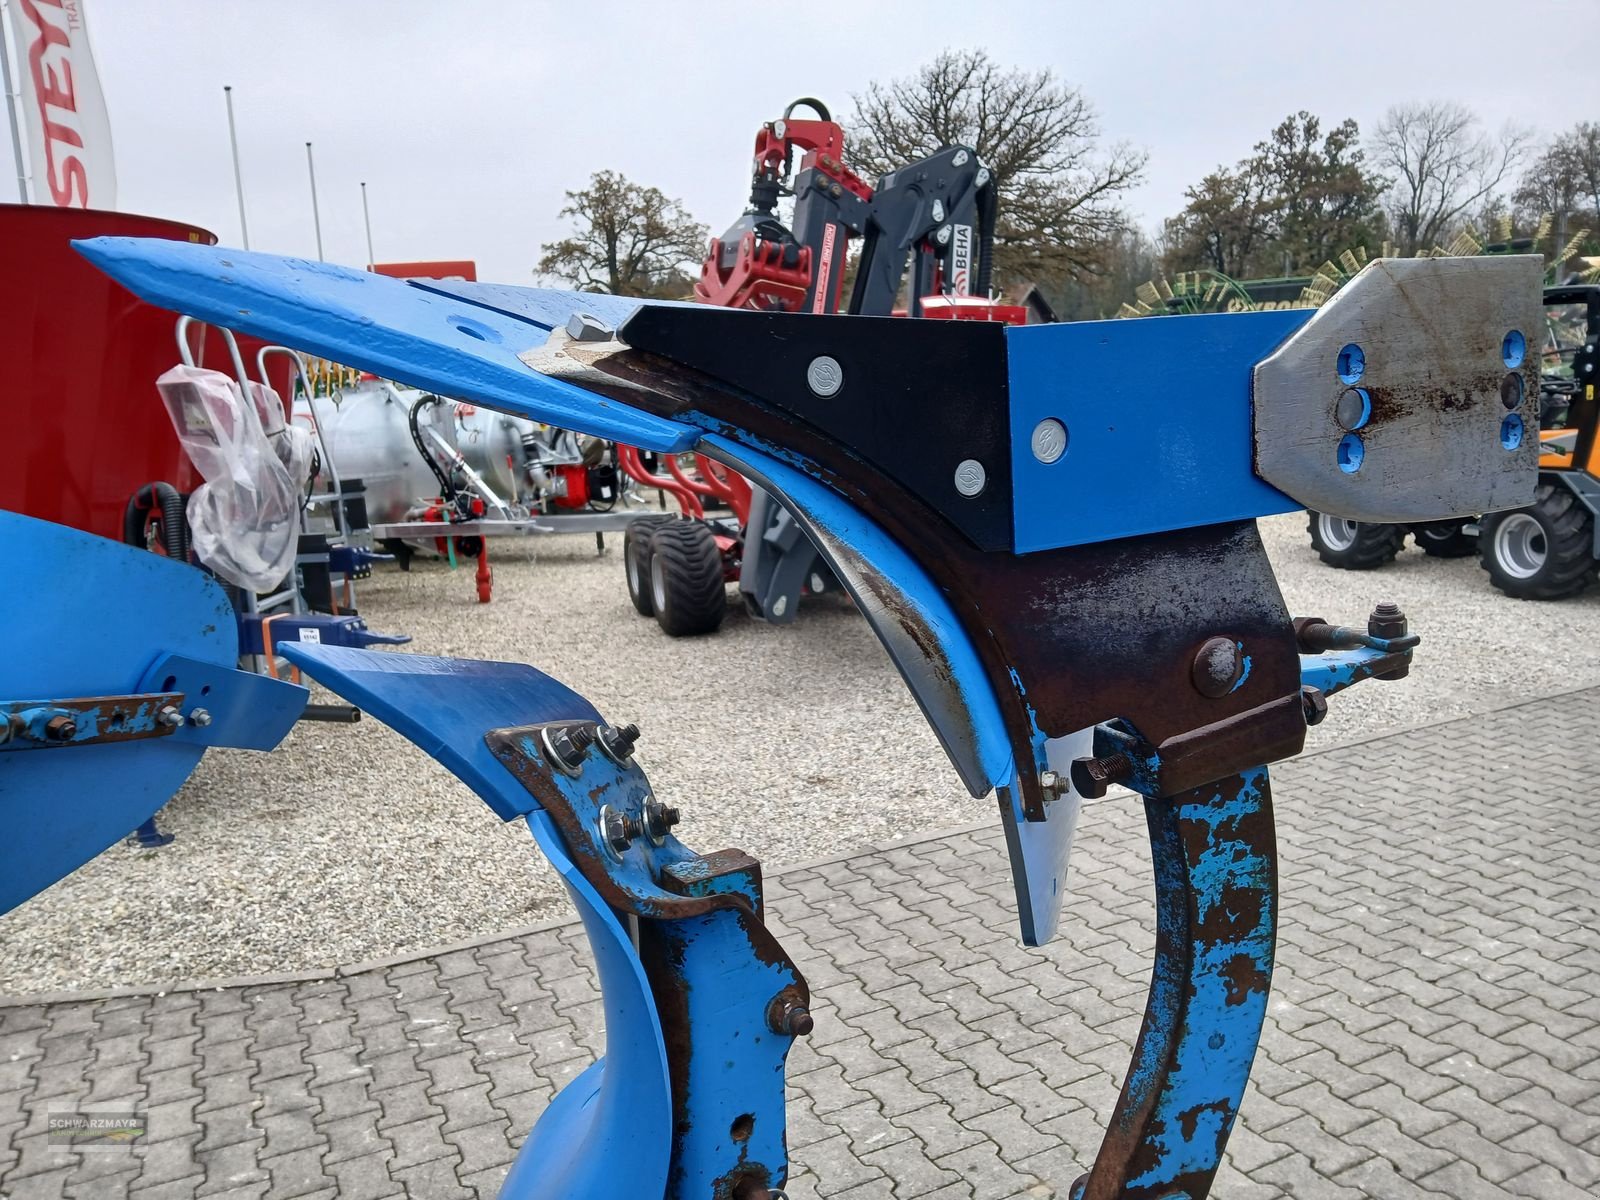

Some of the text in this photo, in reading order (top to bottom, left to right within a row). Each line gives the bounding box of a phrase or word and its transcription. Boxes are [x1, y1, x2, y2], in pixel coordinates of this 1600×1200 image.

[64, 0, 80, 33] TRA
[20, 0, 88, 209] STEY
[955, 227, 969, 269] BEHA
